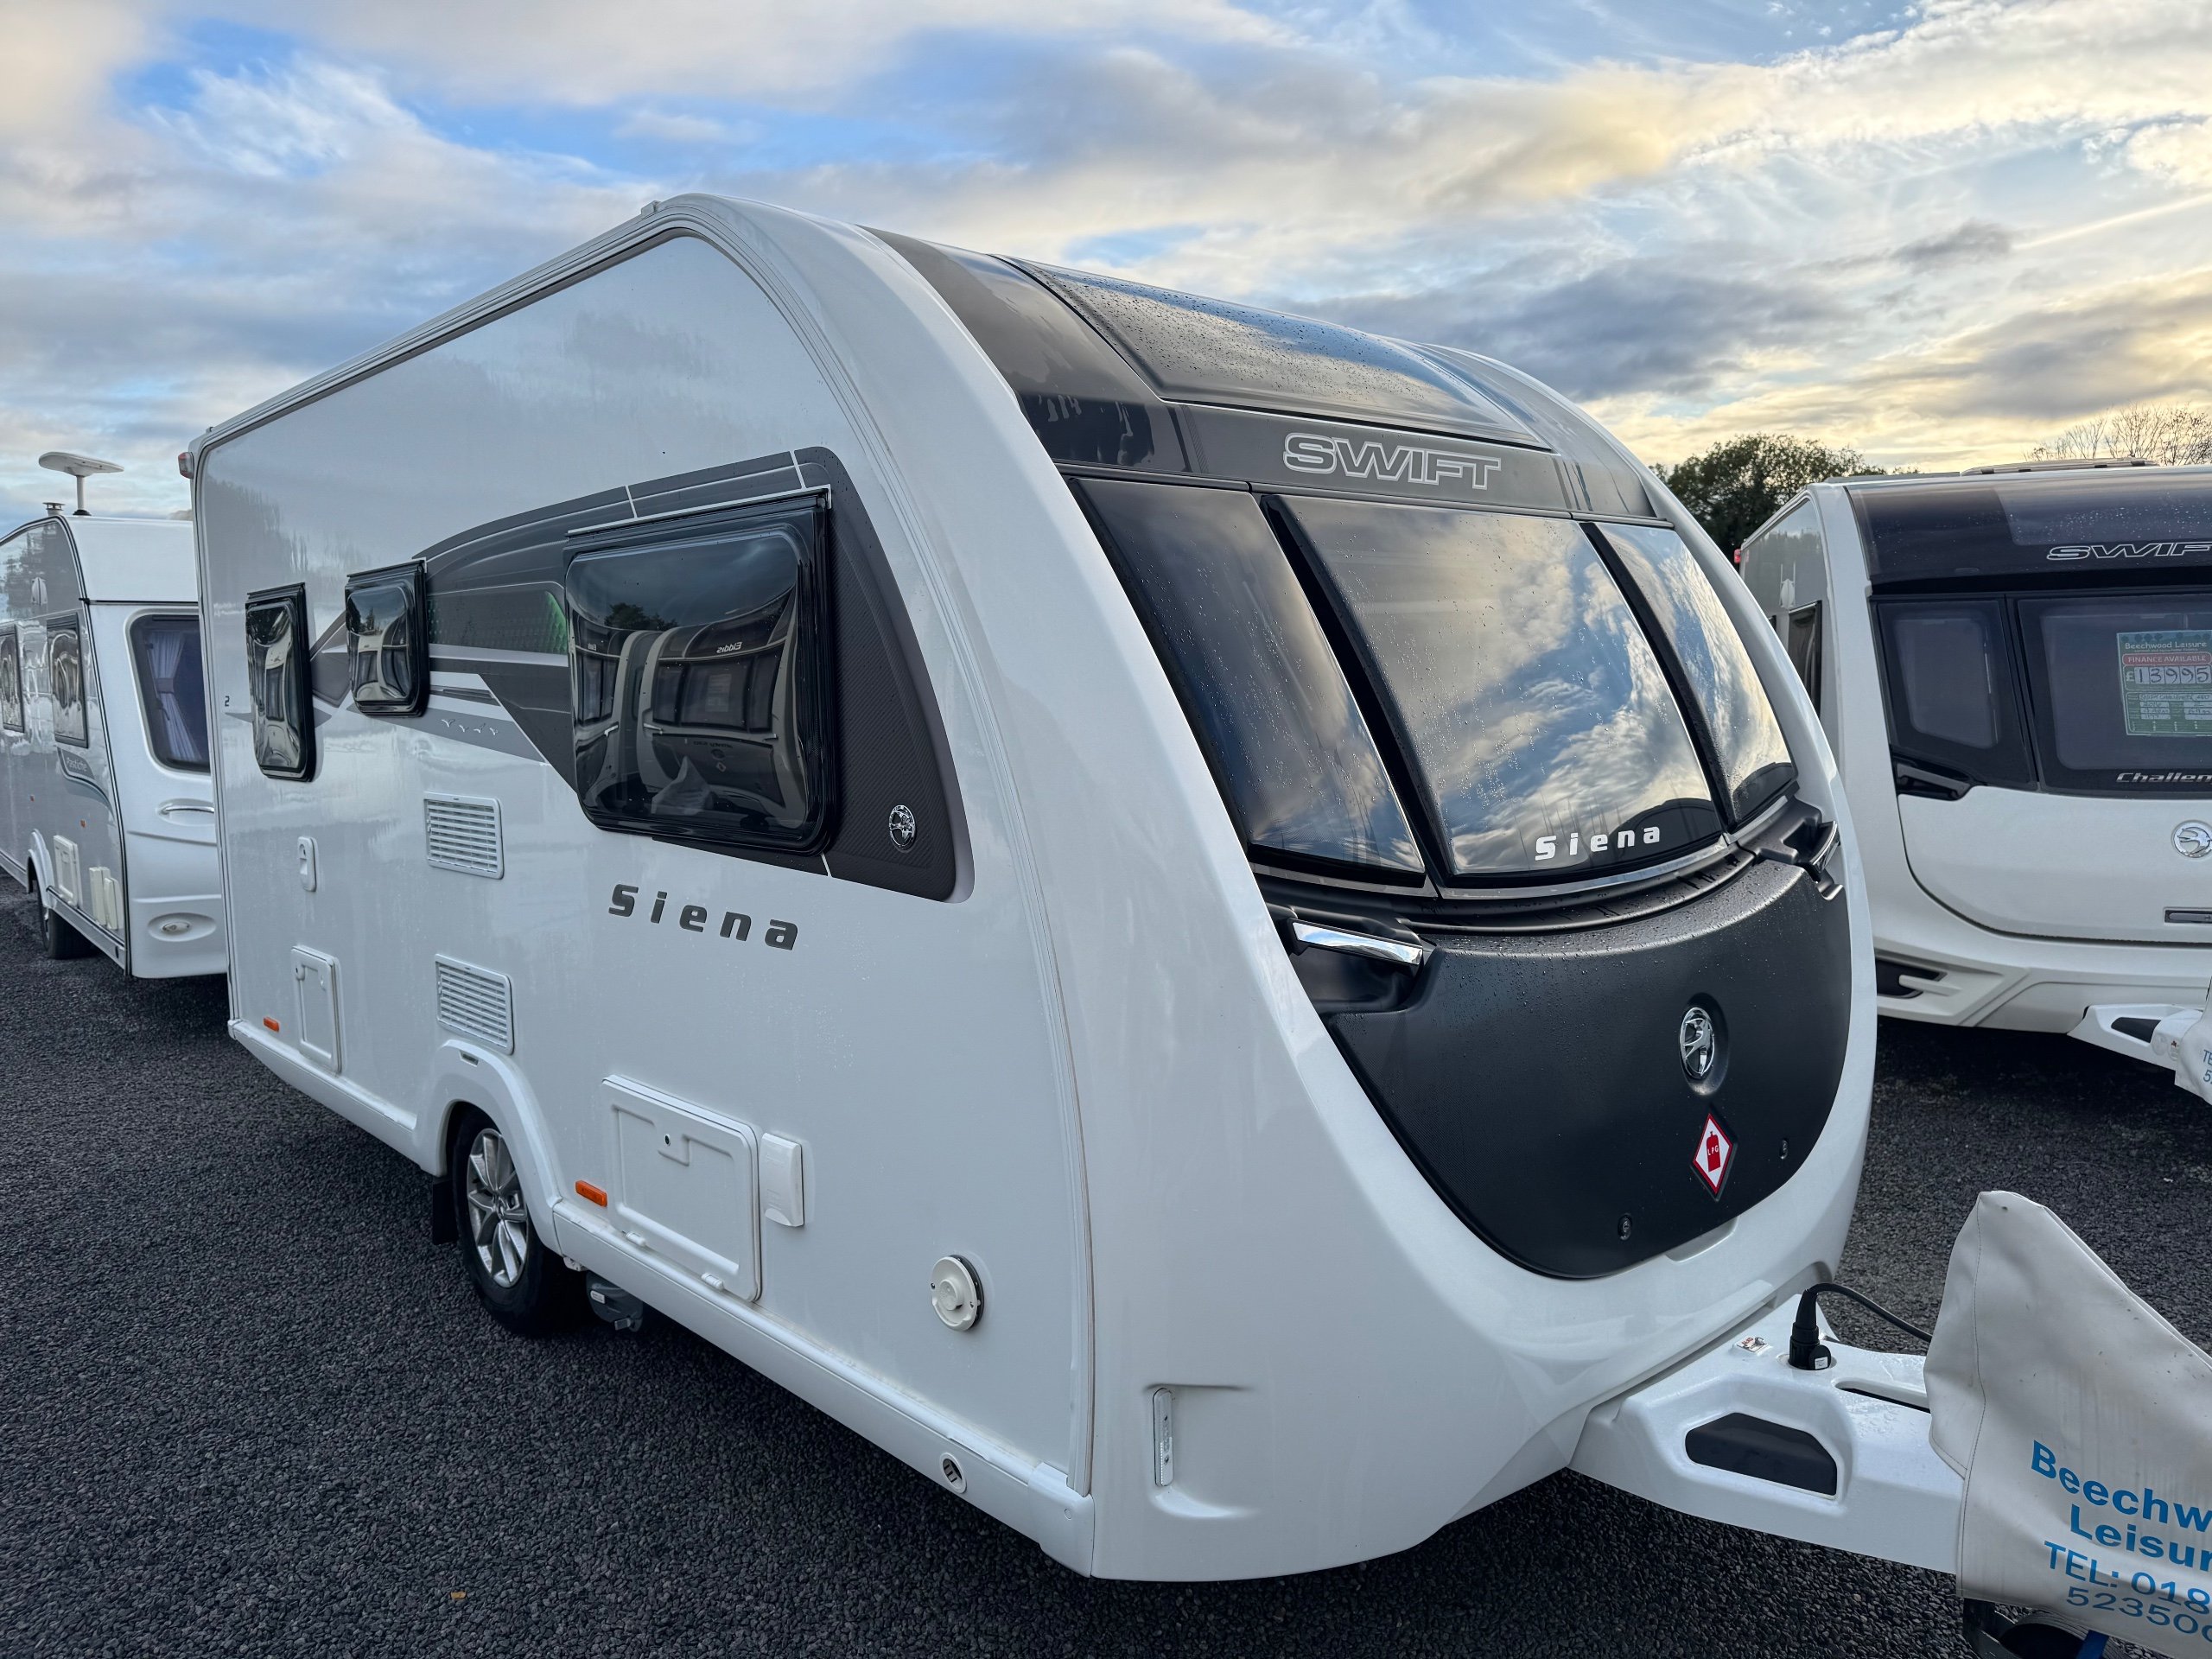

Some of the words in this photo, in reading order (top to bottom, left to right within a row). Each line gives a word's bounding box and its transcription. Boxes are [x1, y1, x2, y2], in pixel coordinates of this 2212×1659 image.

[1283, 433, 1501, 490] SWIFT
[225, 695, 230, 707] 2
[2116, 772, 2212, 785] Challen
[1535, 826, 1660, 861] Siena
[608, 883, 798, 951] Siena
[2202, 1070, 2212, 1084] 5
[1707, 1145, 1719, 1155] LPG
[2031, 1440, 2212, 1533] Beechw
[2044, 1541, 2120, 1588] TEL:
